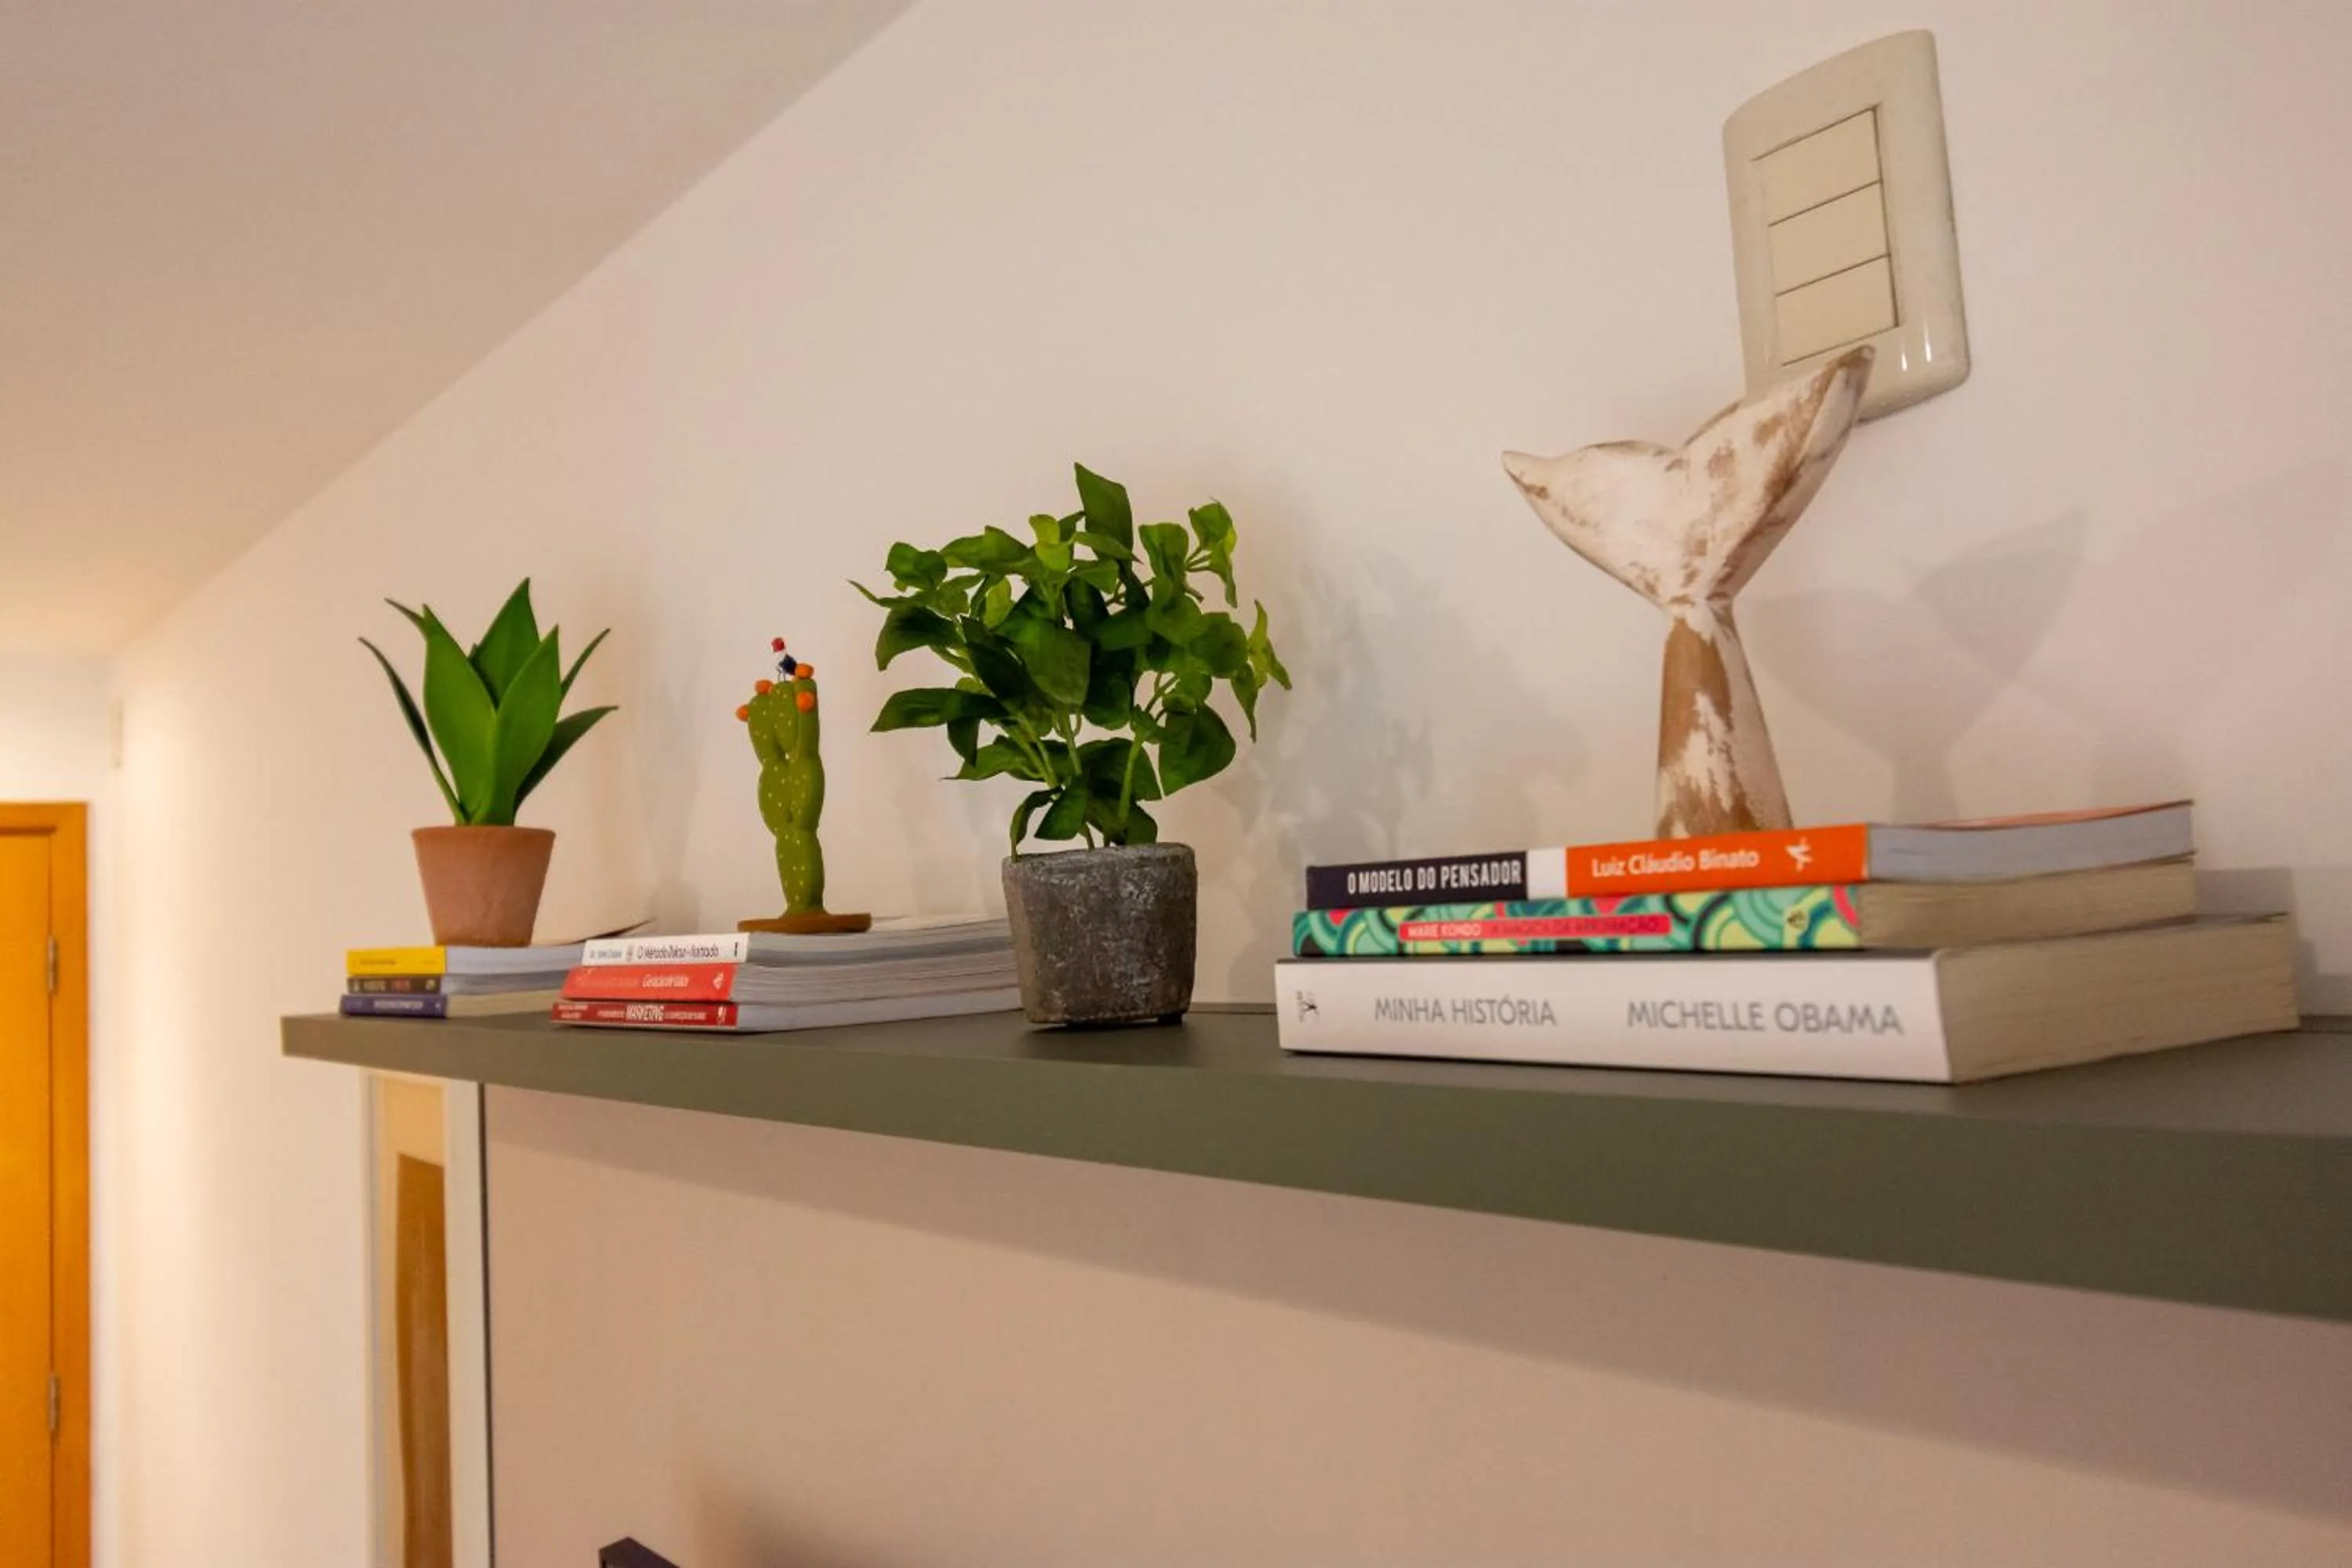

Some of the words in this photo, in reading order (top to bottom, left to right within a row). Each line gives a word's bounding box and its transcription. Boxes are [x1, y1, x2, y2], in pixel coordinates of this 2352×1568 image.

[1347, 872, 1356, 895] O
[1359, 868, 1413, 894] MODELO
[1417, 866, 1436, 891] DO
[1440, 859, 1522, 889] PENSADOR
[1592, 857, 1626, 878] Luiz
[1628, 851, 1696, 876] Cláudio
[1698, 848, 1761, 870] Binato
[1374, 996, 1446, 1022] MINHA
[1451, 993, 1558, 1026] HISTÓRIA
[1627, 1000, 1766, 1033] MICHELLE
[1775, 1001, 1905, 1036] OBAMA
